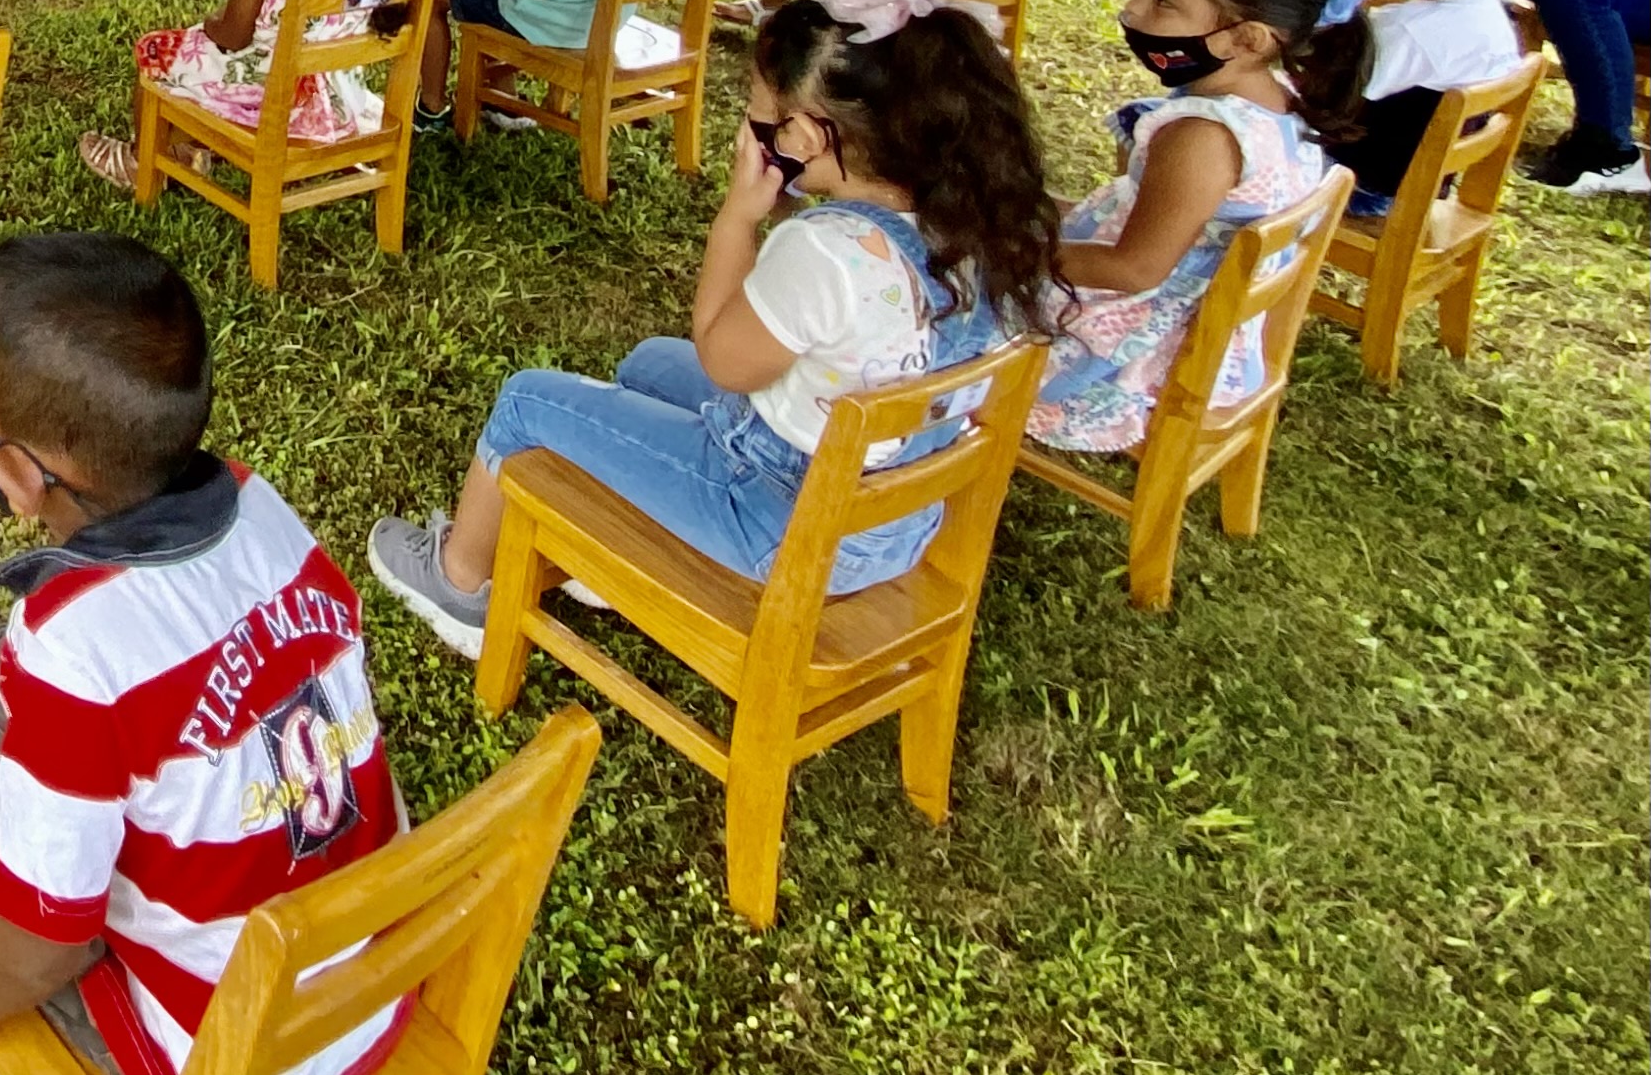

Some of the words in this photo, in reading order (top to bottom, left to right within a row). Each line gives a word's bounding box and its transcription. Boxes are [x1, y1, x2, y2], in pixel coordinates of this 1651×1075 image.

[180, 618, 264, 766] FIRST
[255, 587, 361, 646] MATE
[282, 707, 343, 835] 9
